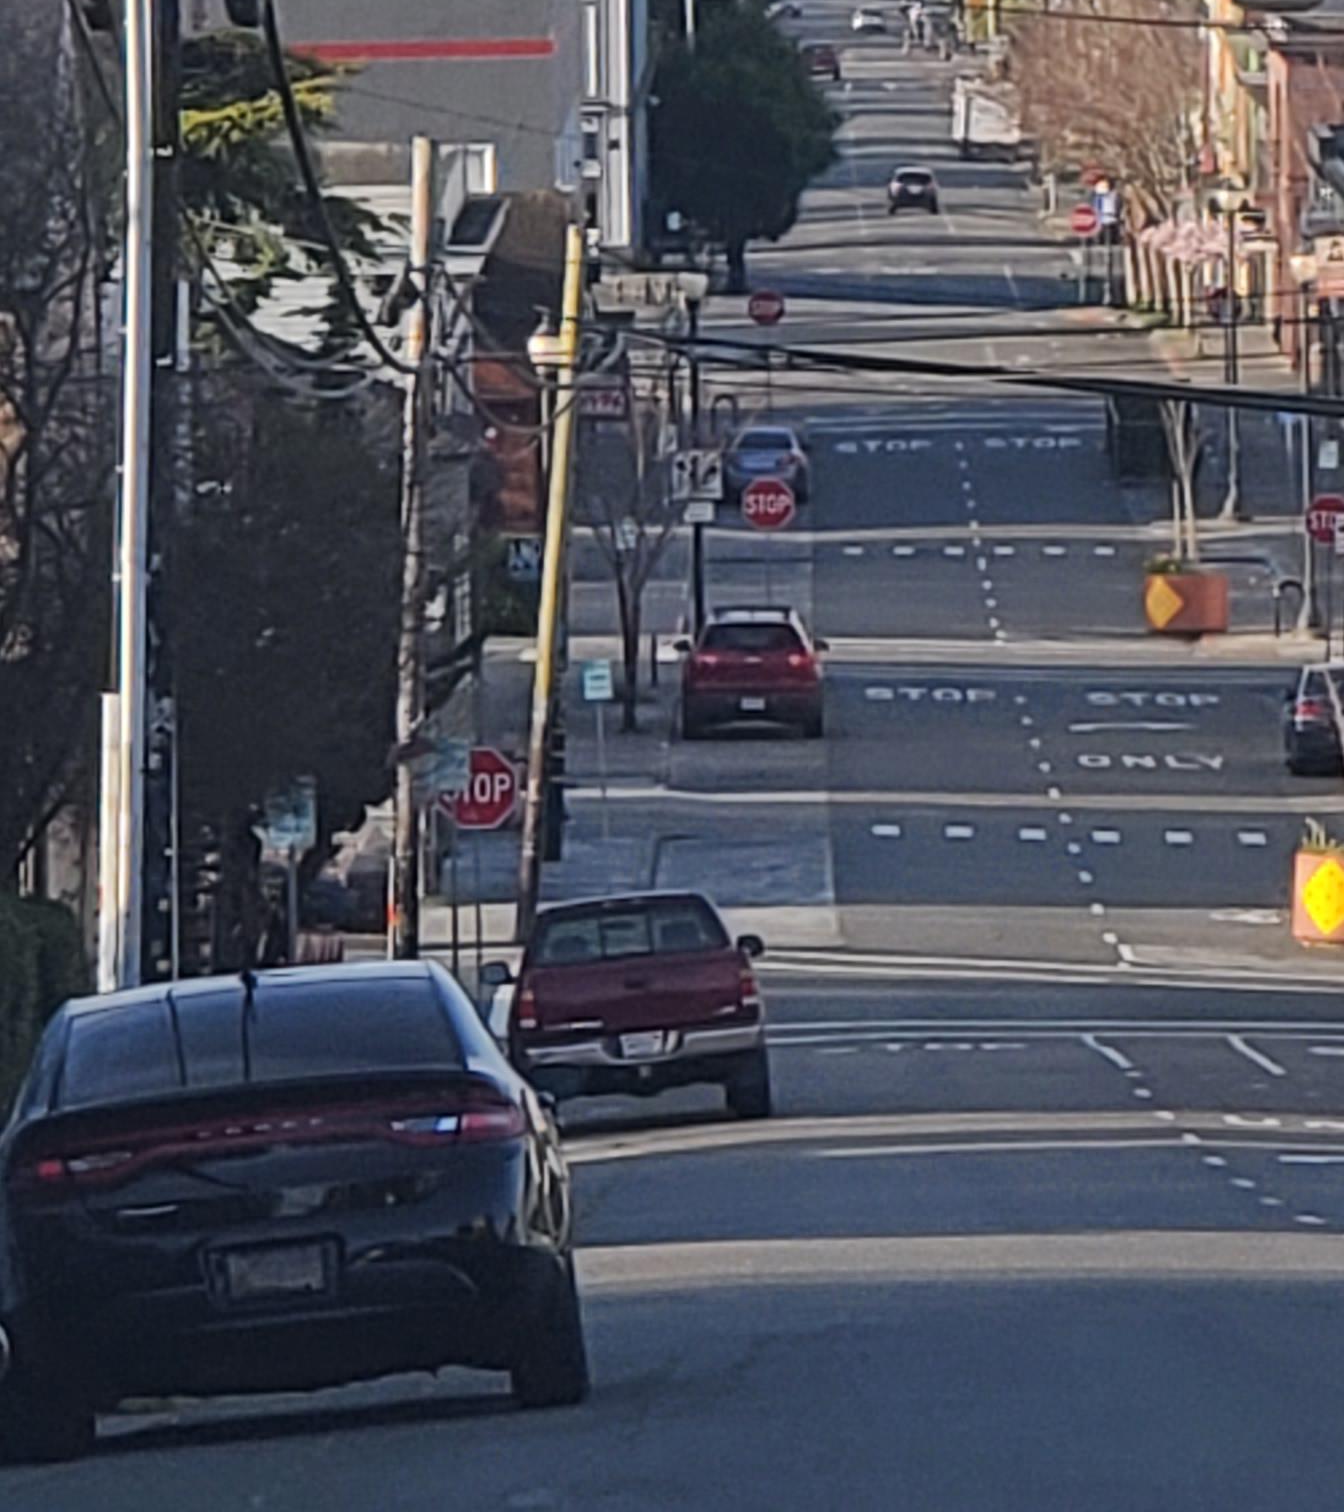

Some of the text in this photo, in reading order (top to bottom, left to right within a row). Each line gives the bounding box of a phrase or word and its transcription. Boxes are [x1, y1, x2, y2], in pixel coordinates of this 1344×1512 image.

[745, 494, 791, 515] STOP
[865, 687, 1220, 706] STOP STOP
[1078, 754, 1224, 770] ONLY
